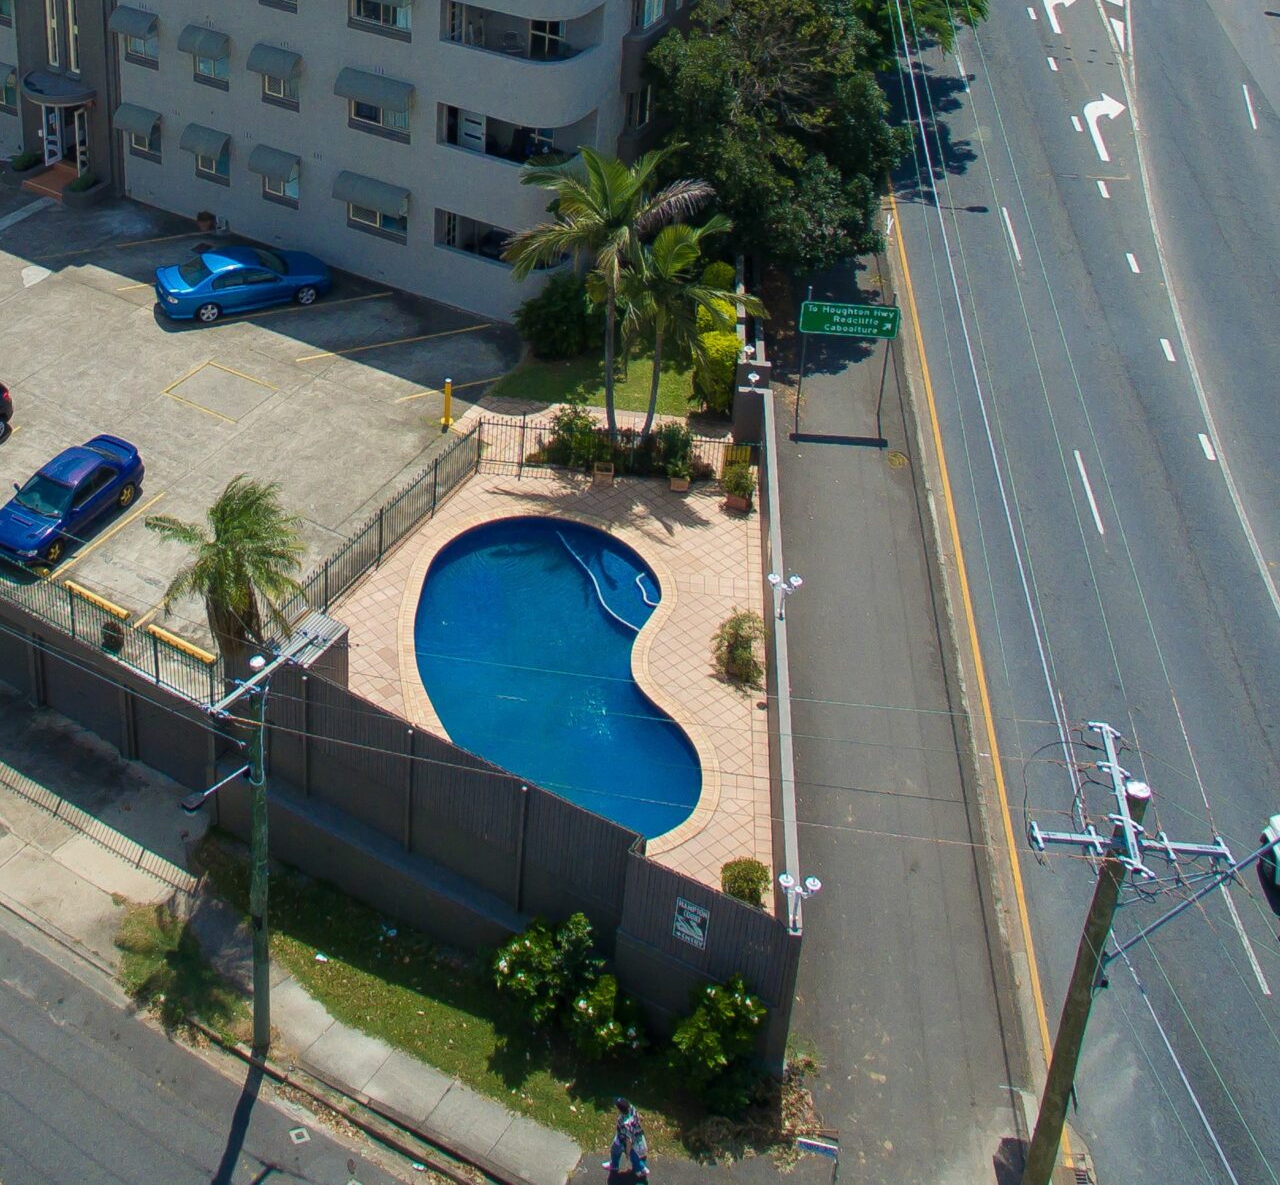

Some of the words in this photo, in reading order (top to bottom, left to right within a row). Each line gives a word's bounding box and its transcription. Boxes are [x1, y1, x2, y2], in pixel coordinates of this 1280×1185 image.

[808, 304, 818, 312] To
[822, 305, 870, 316] Houghton
[873, 310, 895, 318] Hwy
[833, 315, 879, 325] Redcliffe
[824, 324, 878, 334] Caboolture
[678, 900, 708, 918] HAMPTON
[681, 933, 704, 947] ENTRY
